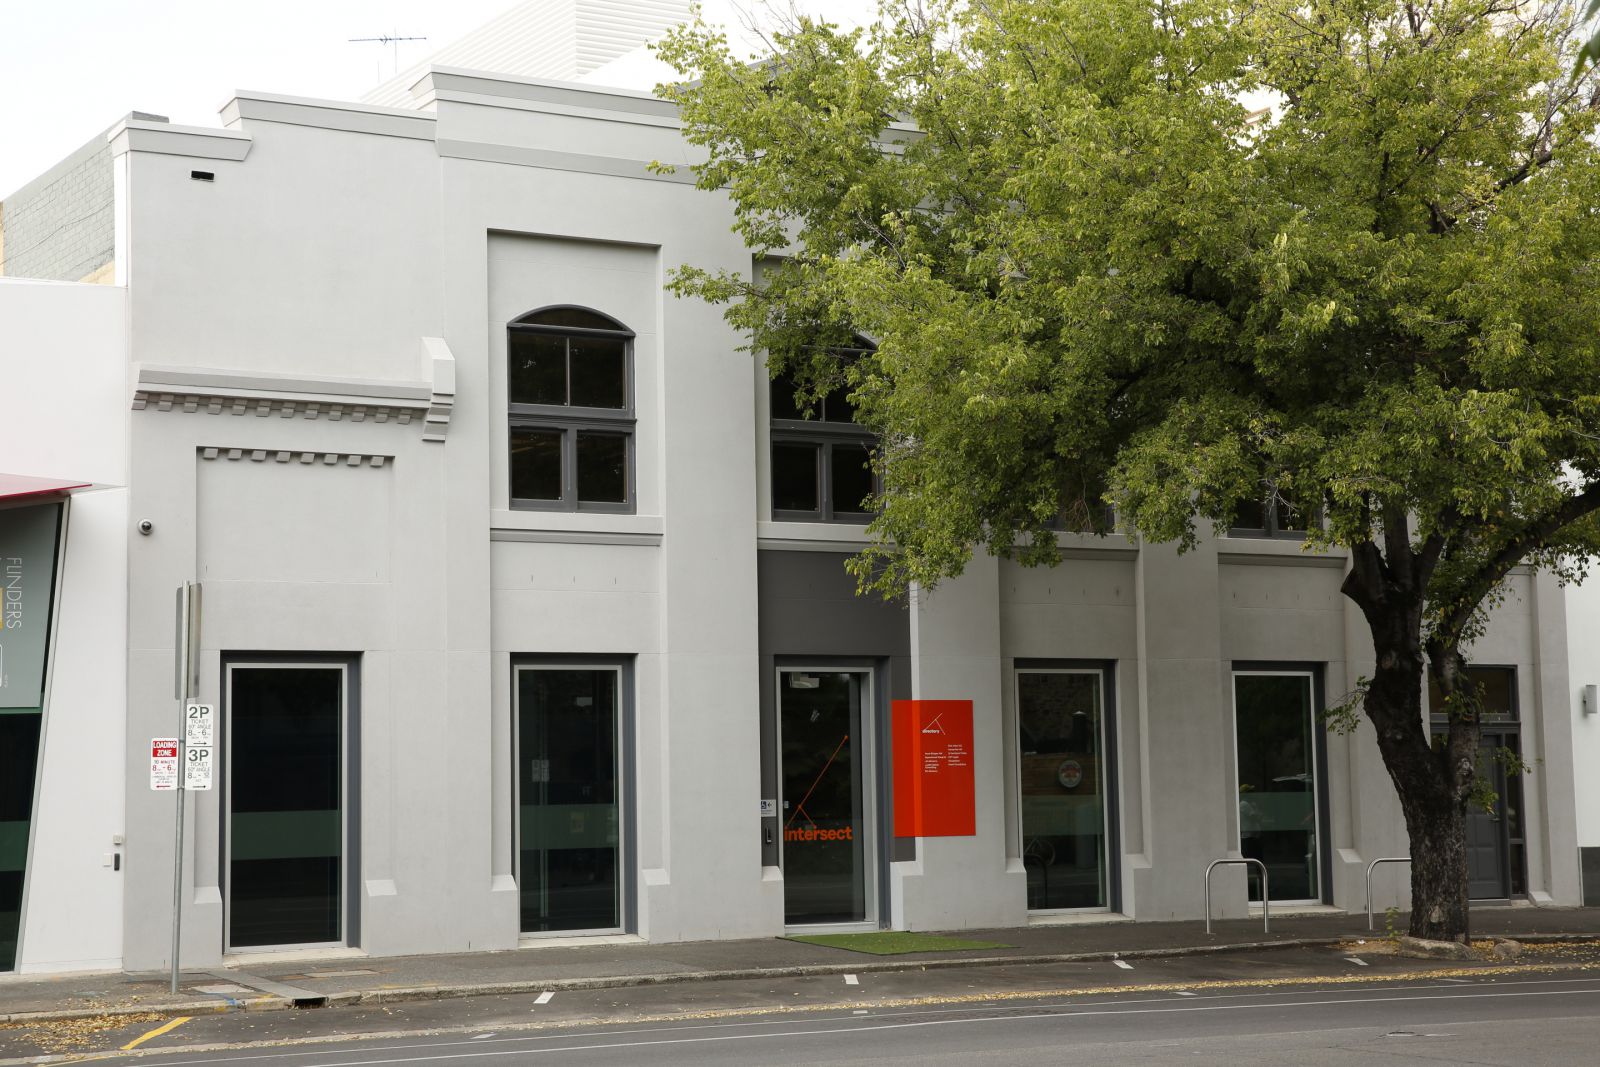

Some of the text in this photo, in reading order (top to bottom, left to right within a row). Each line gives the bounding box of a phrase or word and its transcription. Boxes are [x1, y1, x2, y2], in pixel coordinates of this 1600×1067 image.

[6, 557, 22, 629] FLINDERS
[189, 706, 210, 719] 2P
[157, 749, 172, 757] ZONE
[188, 749, 209, 762] 3P
[784, 826, 853, 841] intersect
